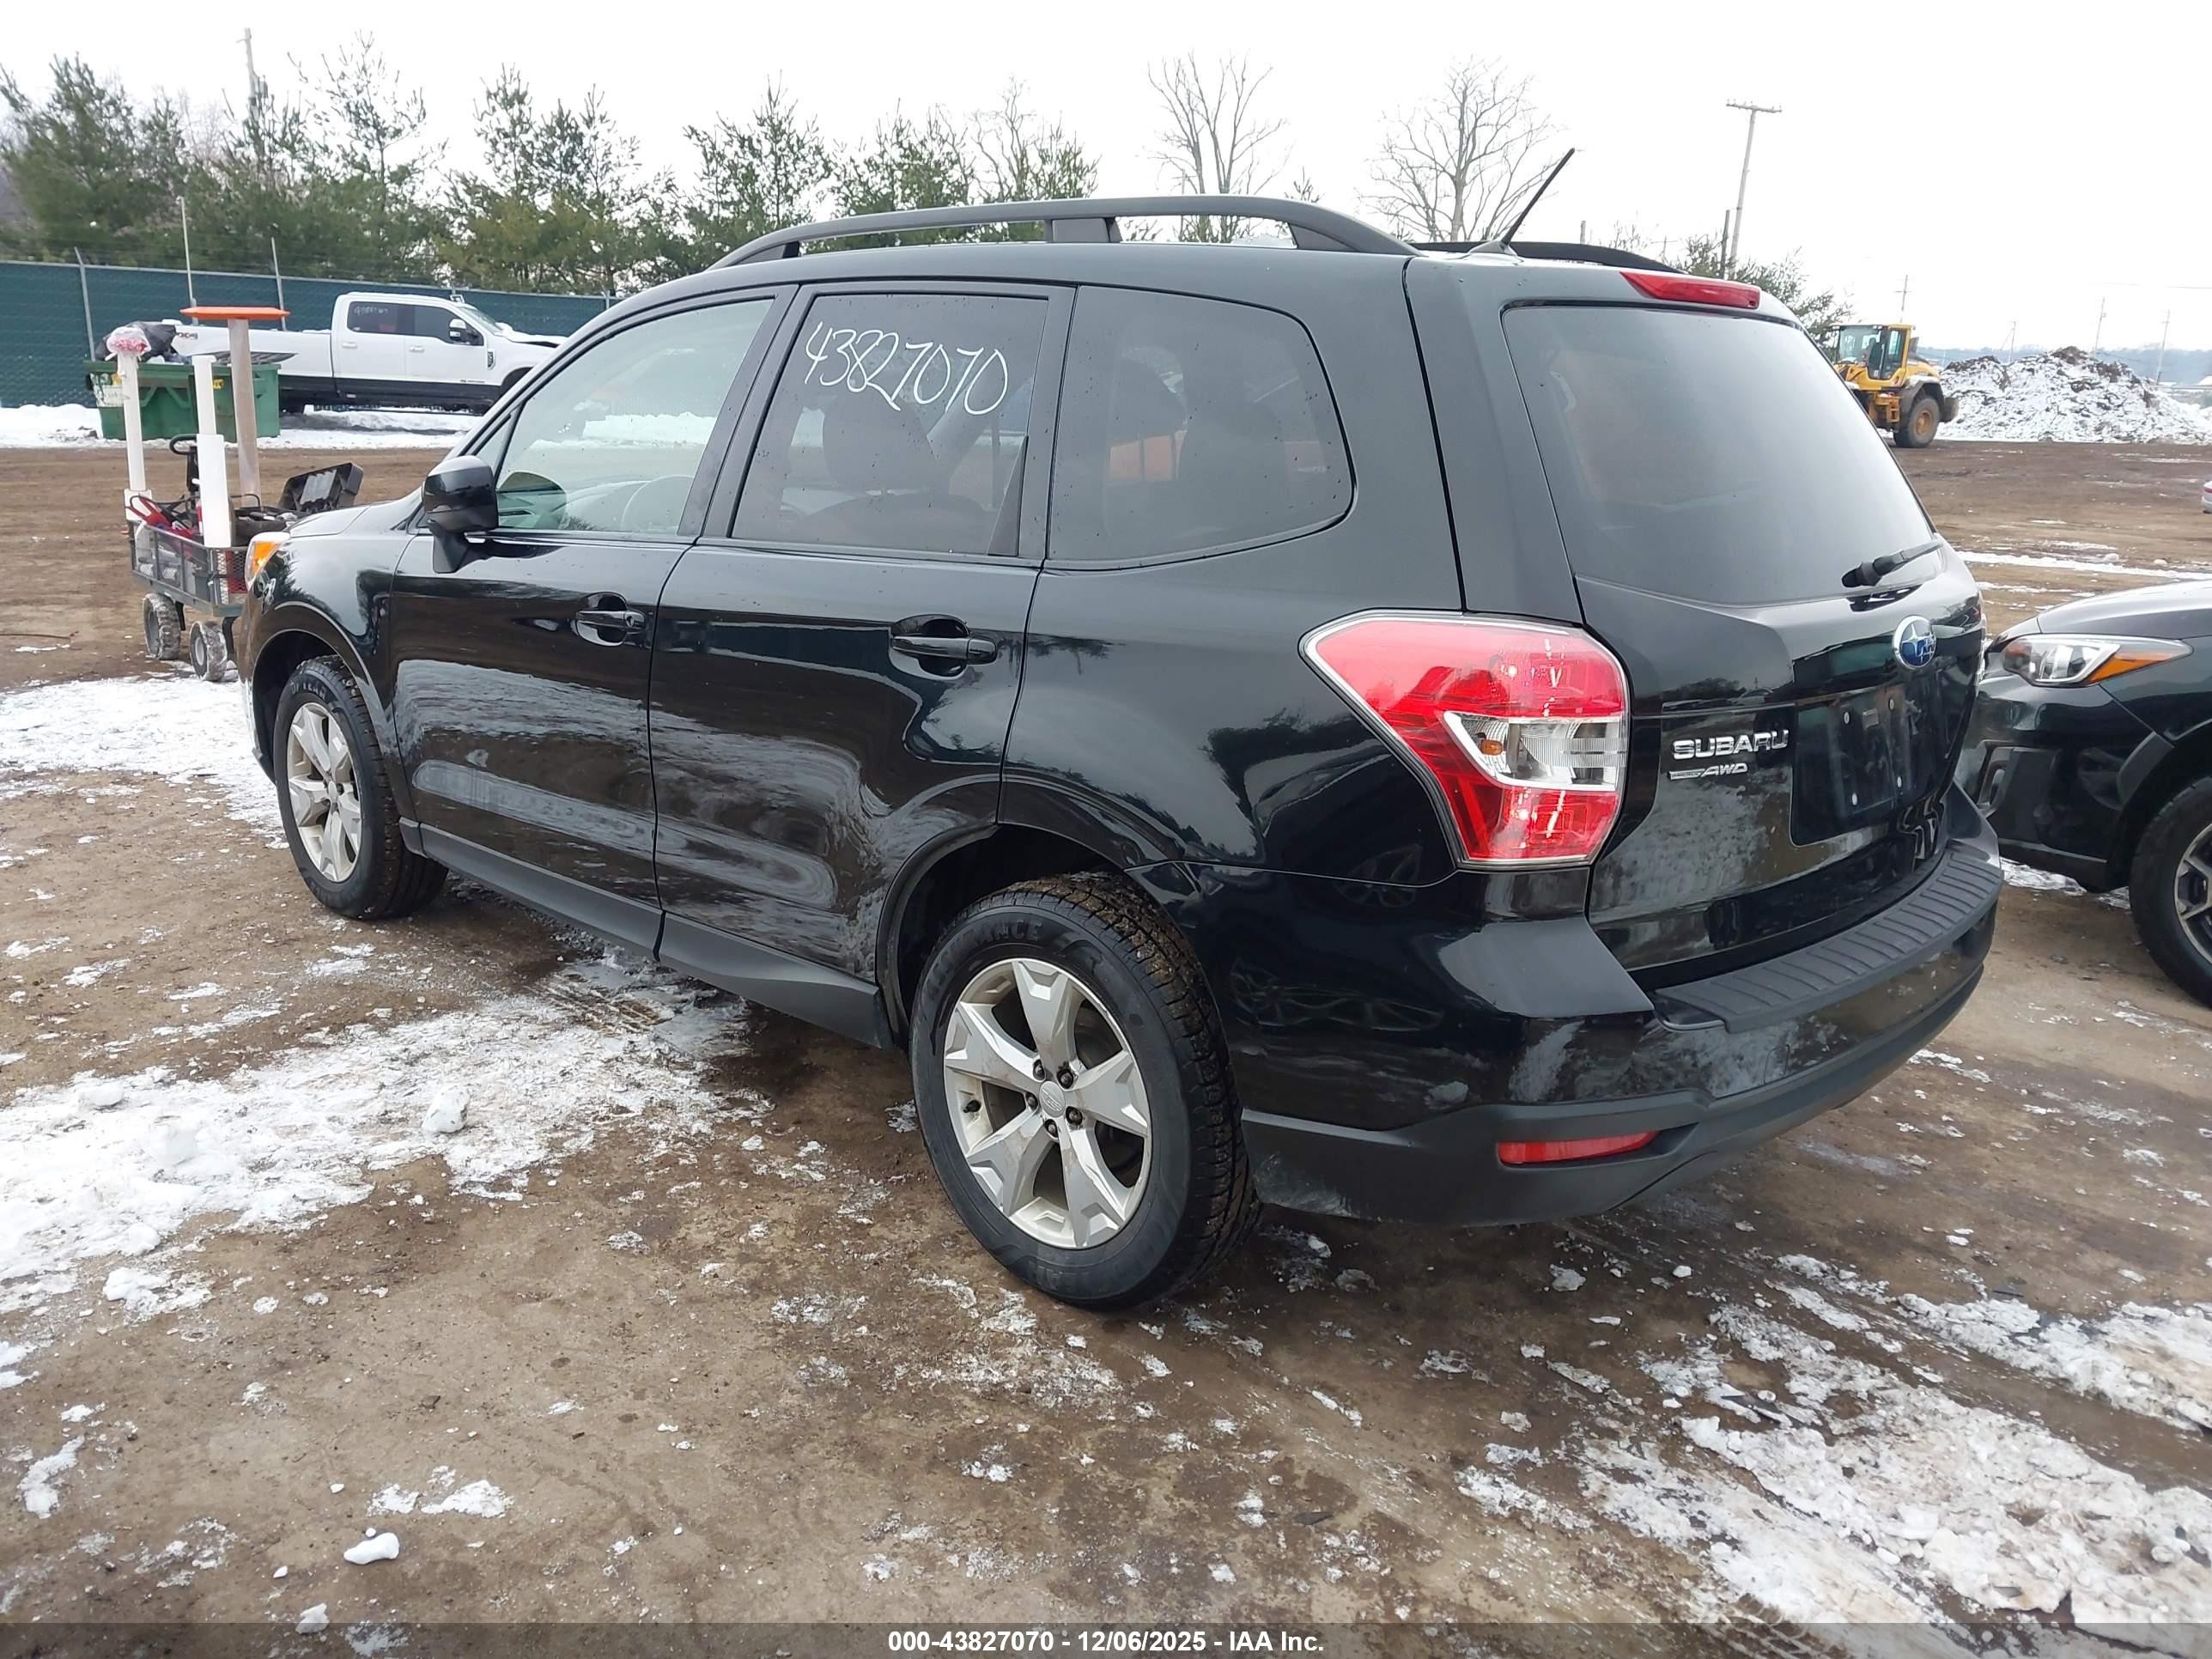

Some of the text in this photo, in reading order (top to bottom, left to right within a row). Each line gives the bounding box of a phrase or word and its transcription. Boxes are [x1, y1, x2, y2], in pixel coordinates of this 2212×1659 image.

[804, 320, 1009, 416] 43827070
[1672, 728, 1790, 761] SUBARU
[1700, 763, 1749, 778] AWD
